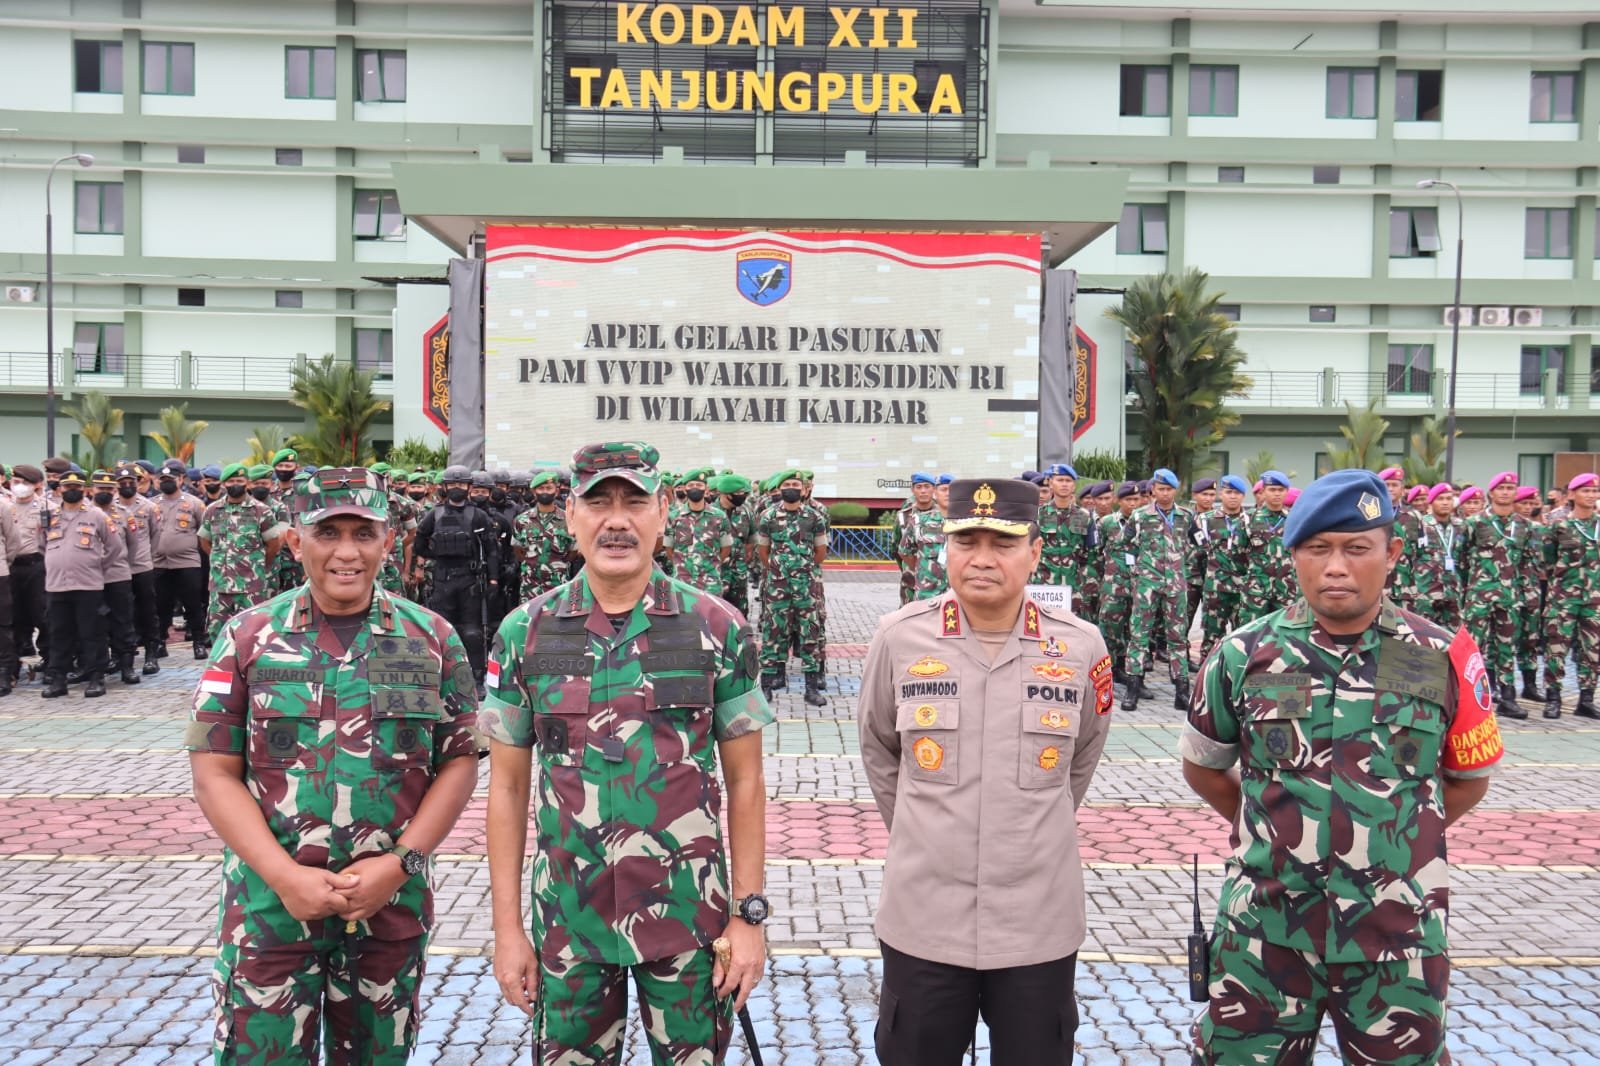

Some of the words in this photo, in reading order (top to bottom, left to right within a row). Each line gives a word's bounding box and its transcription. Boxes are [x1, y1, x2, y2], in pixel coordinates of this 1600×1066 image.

[616, 3, 805, 48] KODAM
[829, 7, 919, 49] XII
[570, 67, 963, 114] TANJUNGPURA
[584, 323, 667, 350] APEL
[674, 325, 778, 352] GELAR
[789, 326, 942, 353] PASUKAN
[519, 358, 587, 385] PAM
[597, 359, 673, 386] VVIP
[683, 361, 789, 388] WAKIL
[798, 363, 959, 390] PRESIDEN
[970, 365, 1005, 391] RI
[596, 395, 631, 421] DI
[640, 396, 787, 423] WILAYAH
[798, 398, 929, 426] KALBAR
[256, 668, 317, 681] SUHARTO
[379, 671, 405, 683] TNI
[1027, 684, 1078, 705] POLRI
